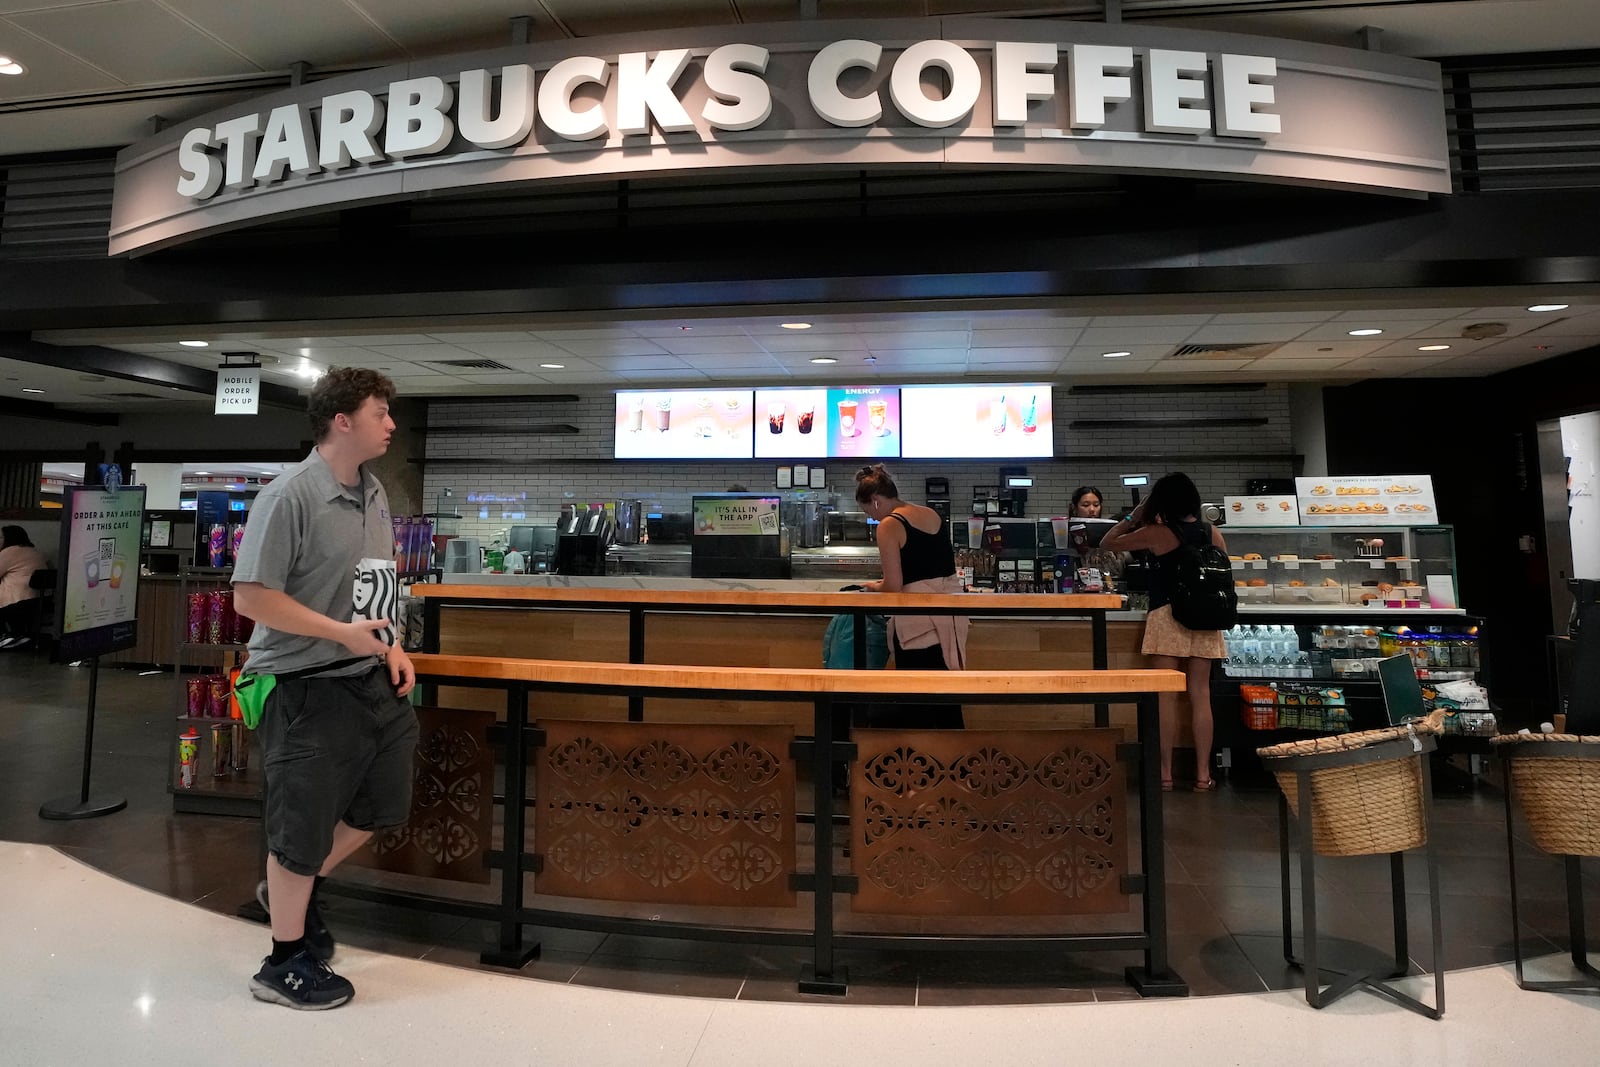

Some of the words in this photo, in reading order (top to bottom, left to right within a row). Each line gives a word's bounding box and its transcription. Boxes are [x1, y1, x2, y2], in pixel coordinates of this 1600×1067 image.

[177, 42, 771, 199] STARBUCKS
[807, 39, 1281, 136] COFFEE
[74, 511, 98, 519] ORDER
[86, 523, 95, 531] AT
[97, 522, 112, 530] THIS
